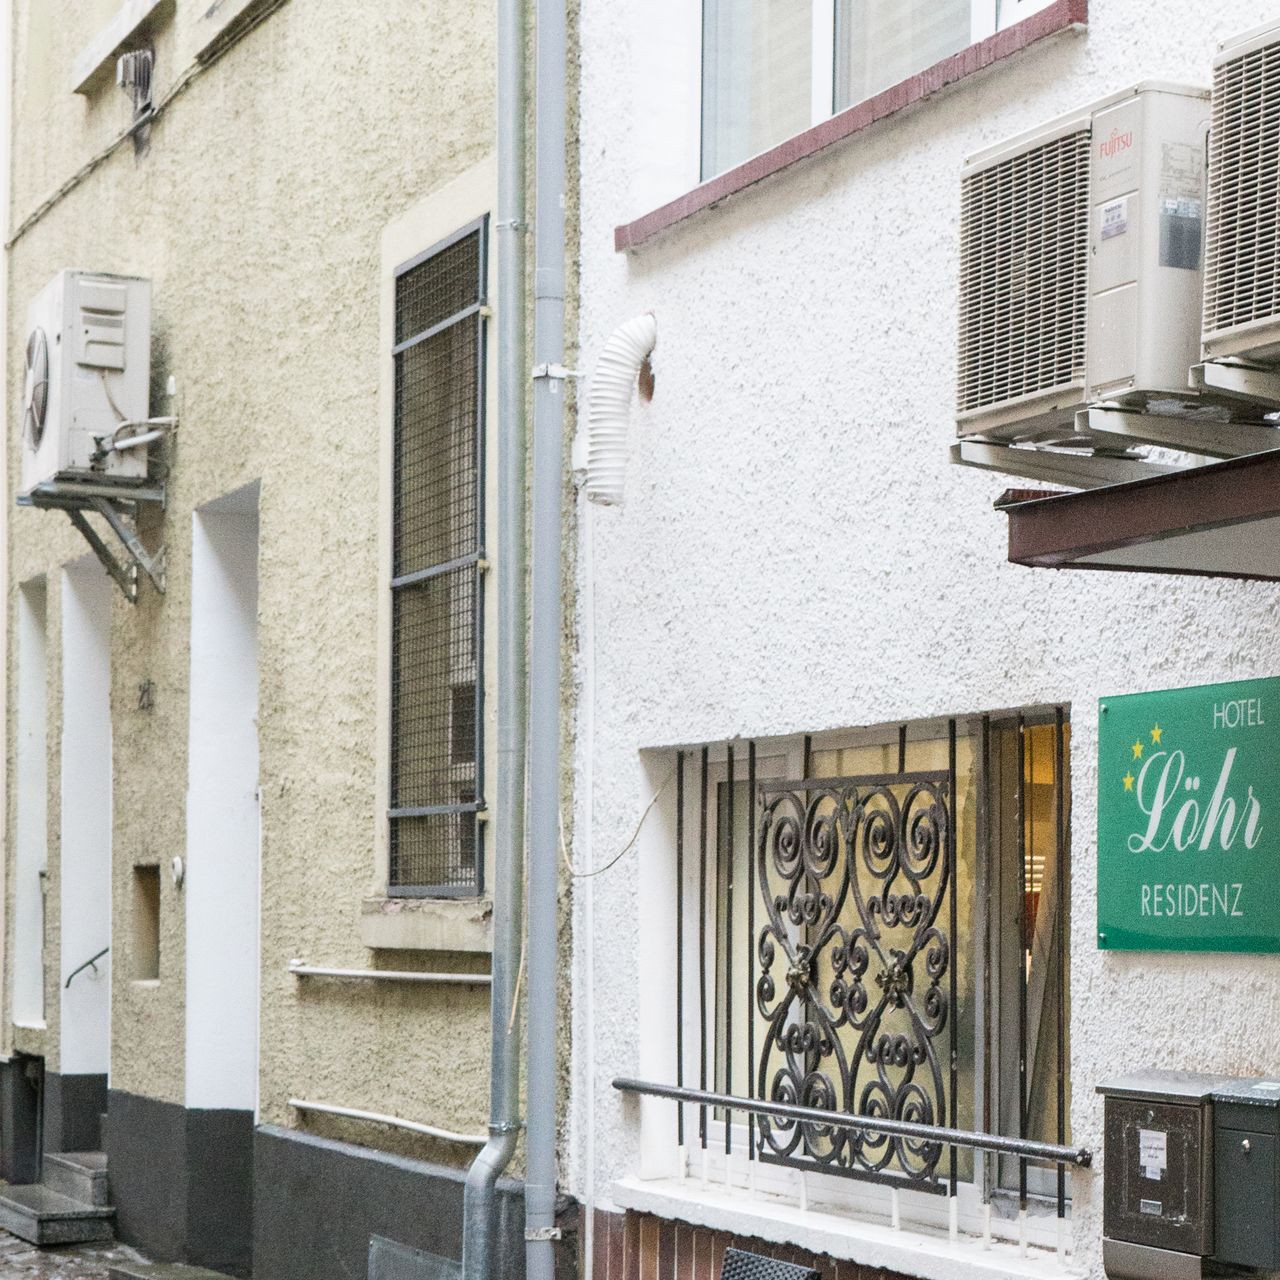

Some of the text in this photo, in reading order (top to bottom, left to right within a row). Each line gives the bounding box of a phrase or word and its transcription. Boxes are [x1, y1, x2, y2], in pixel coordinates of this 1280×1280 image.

[1099, 129, 1132, 159] FUJITSU
[1213, 698, 1265, 729] HOTEL
[1127, 746, 1264, 854] Löhr
[1141, 883, 1244, 917] RESIDENZ
